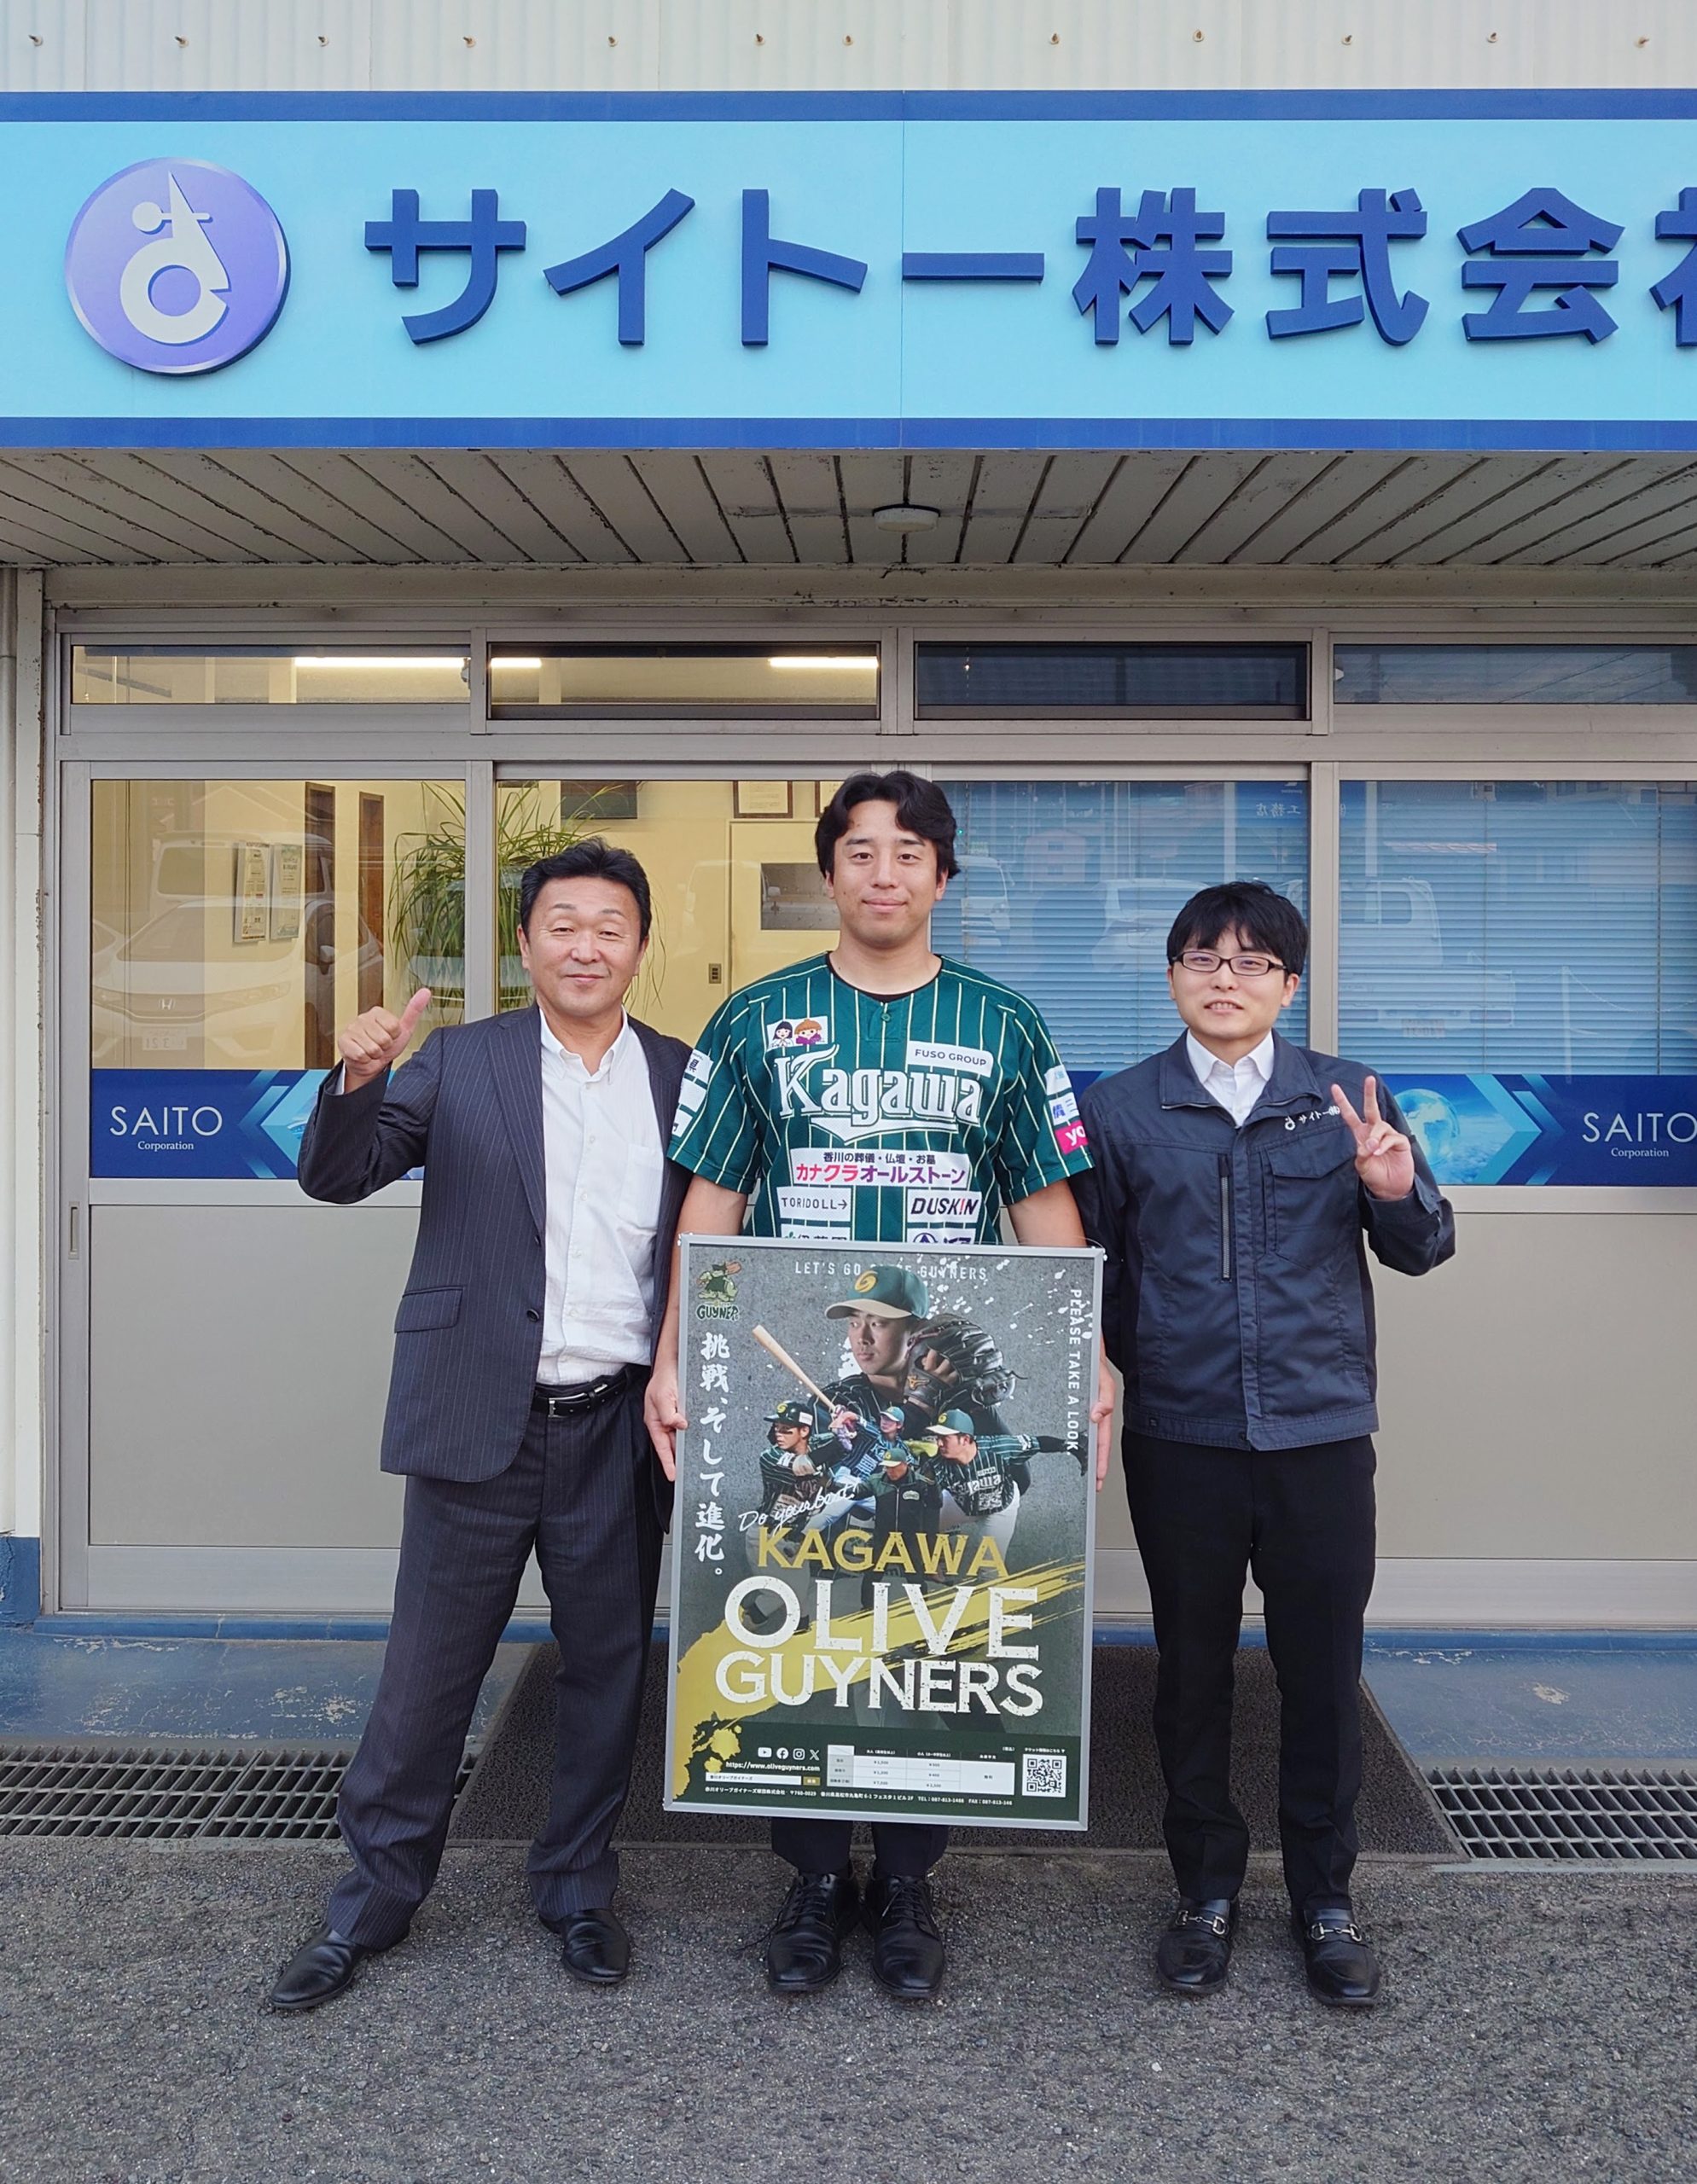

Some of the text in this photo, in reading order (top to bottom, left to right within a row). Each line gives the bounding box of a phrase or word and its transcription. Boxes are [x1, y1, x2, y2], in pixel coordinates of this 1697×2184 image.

[364, 187, 1697, 346] サイトー株式会
[915, 1048, 987, 1066] FUSO GROUP
[774, 1045, 980, 1127] Kagawa
[109, 1106, 223, 1136] SAITO
[1583, 1112, 1697, 1143] SAITO
[137, 1141, 195, 1152] Corporation
[1611, 1147, 1670, 1159] Corporation
[822, 1152, 936, 1165] 香川の葬儀・仏壇・お墓
[796, 1163, 966, 1184] カナクラオールストーン
[781, 1196, 838, 1210] TORIDOLL
[795, 1261, 835, 1275] LET'S
[843, 1263, 862, 1275] GO
[919, 1265, 987, 1281] GUYNERS
[1069, 1289, 1083, 1345] PLEASE
[1068, 1351, 1081, 1389] TAKE
[1067, 1395, 1080, 1405] A
[738, 1510, 768, 1532] Do
[758, 1528, 1008, 1577] KAGAWA
[724, 1575, 1040, 1661] OLIVE
[714, 1650, 1043, 1717] GUYNERS
